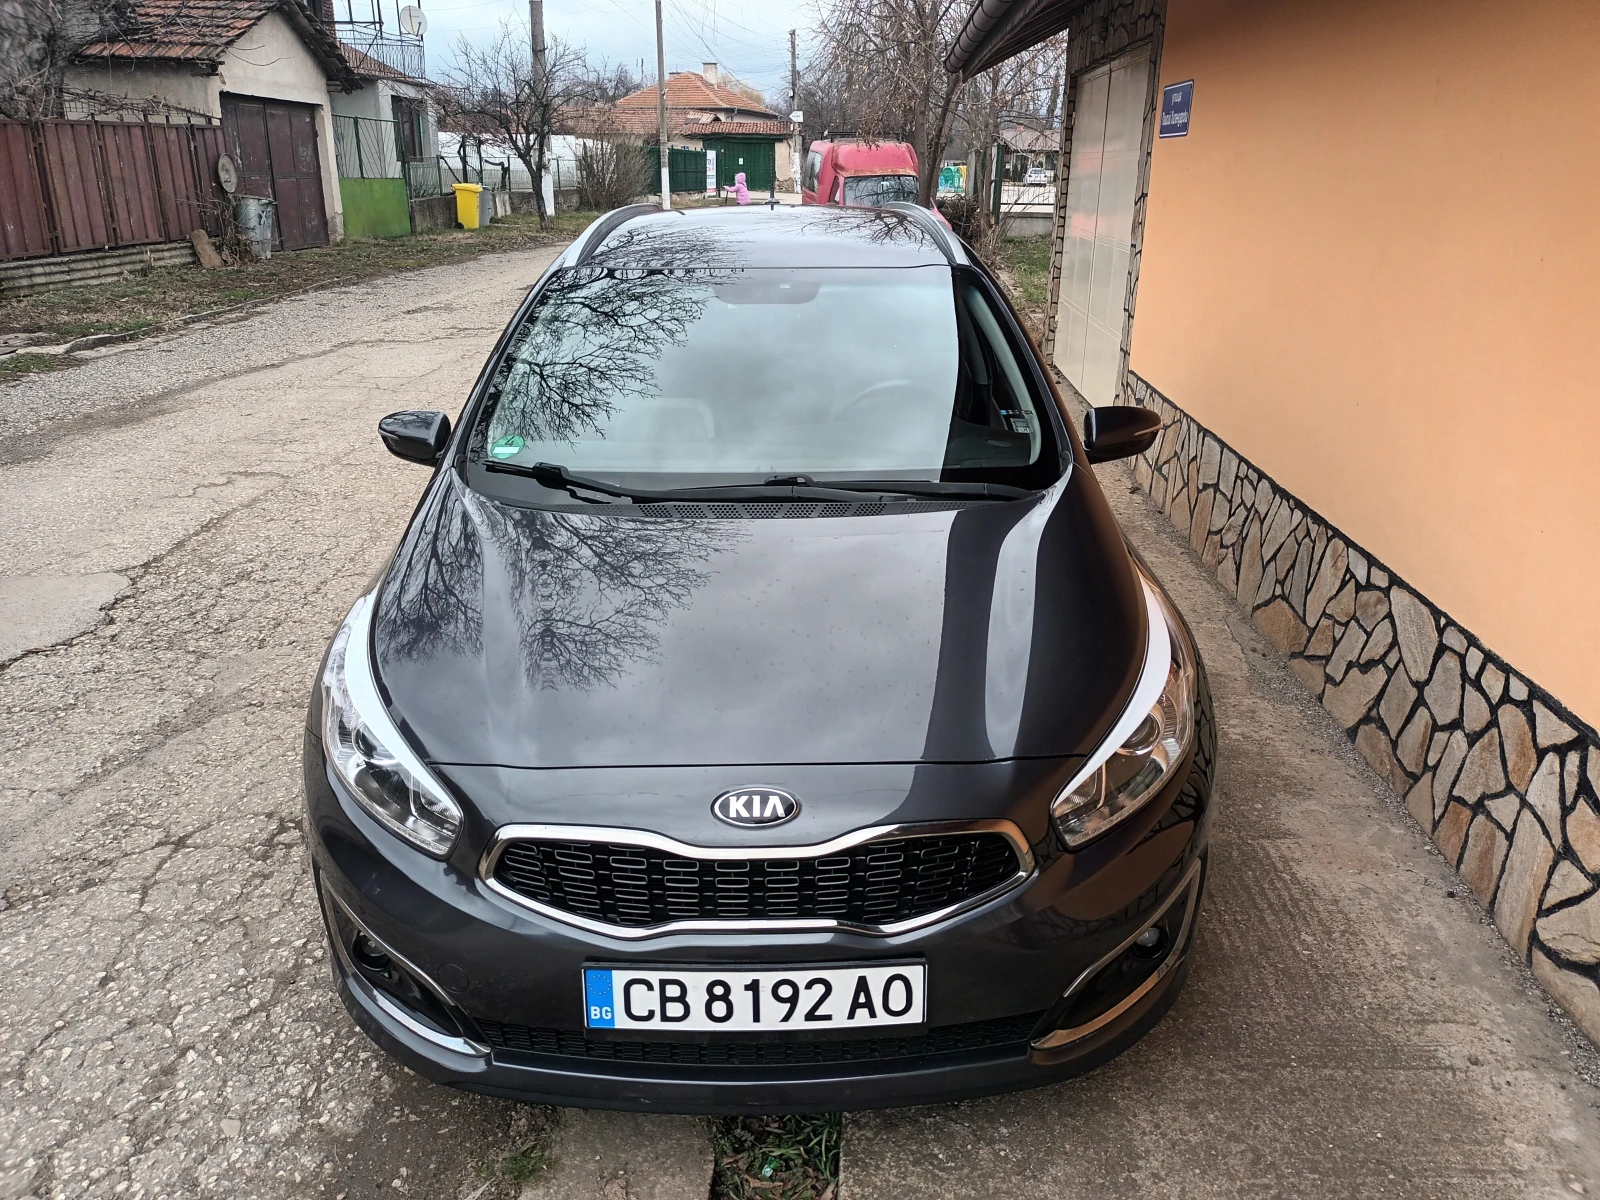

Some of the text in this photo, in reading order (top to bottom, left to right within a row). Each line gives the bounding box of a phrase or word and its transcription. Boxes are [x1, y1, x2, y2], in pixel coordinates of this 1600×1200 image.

[504, 435, 516, 447] 4
[729, 795, 785, 817] KIA
[623, 973, 914, 1023] CB 8192 AO
[590, 1006, 612, 1020] BG
